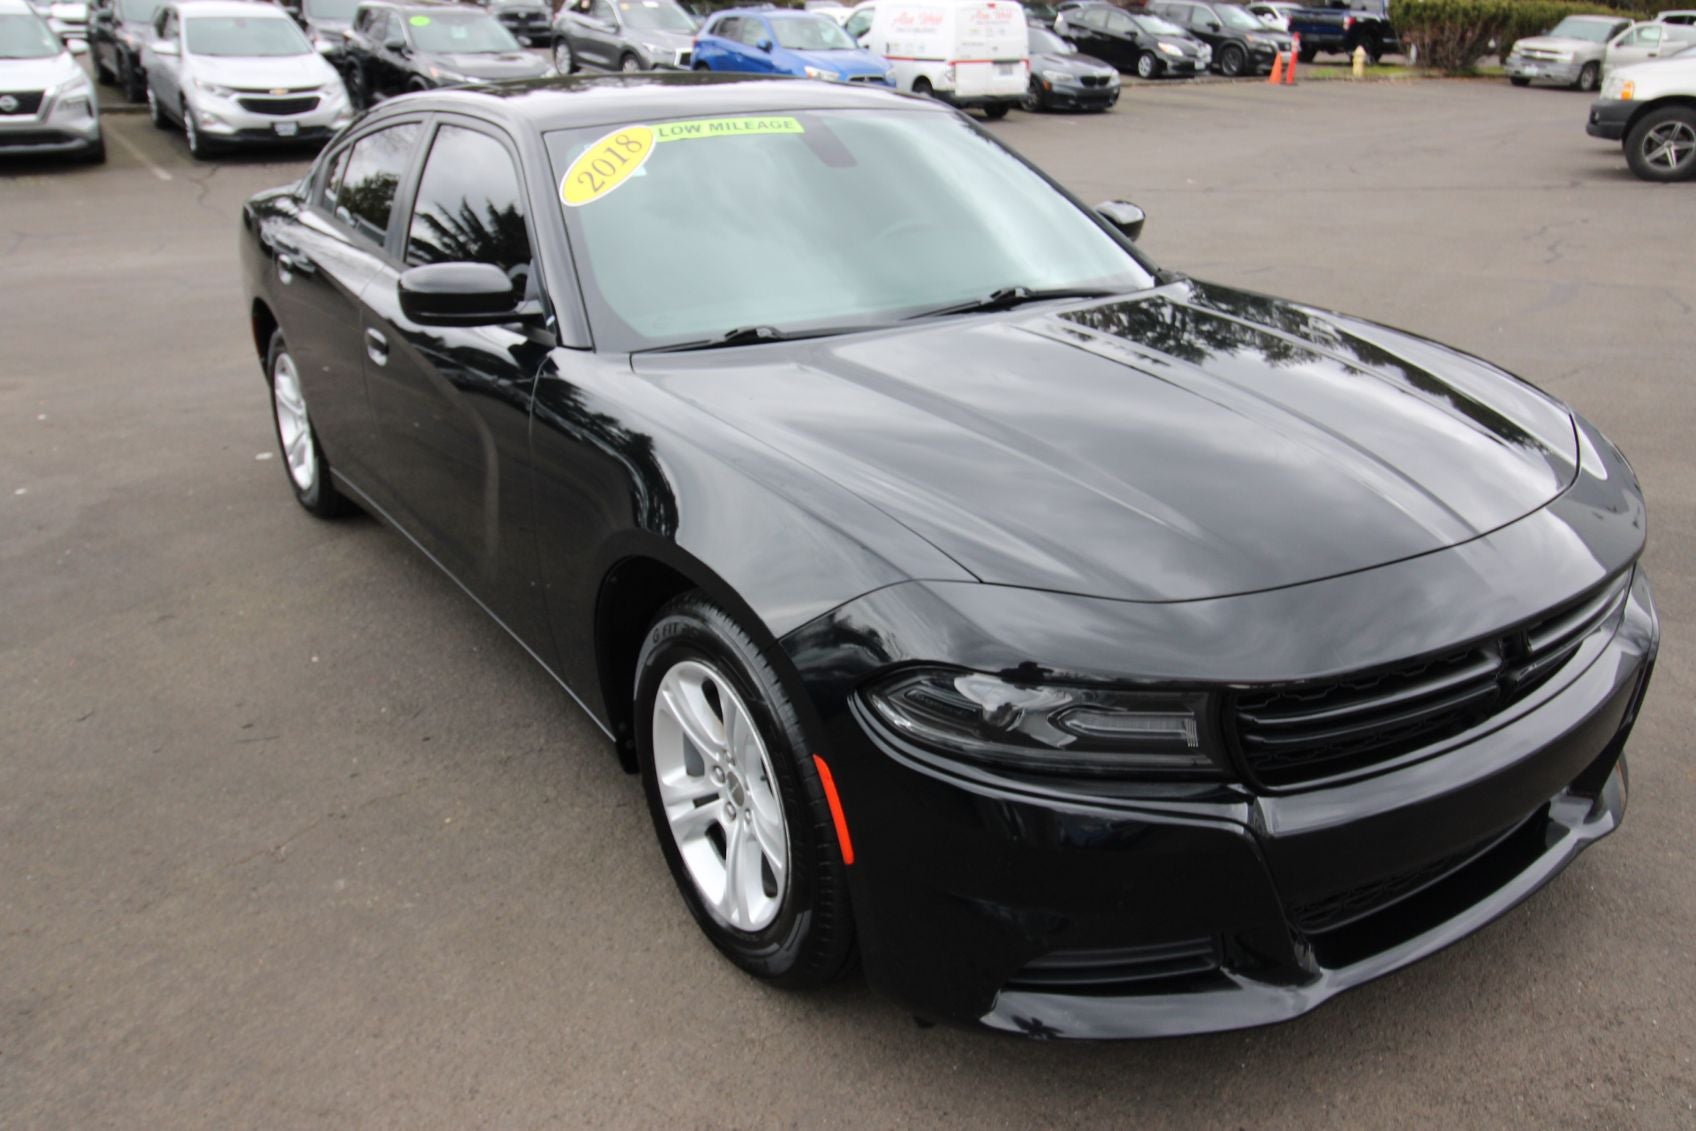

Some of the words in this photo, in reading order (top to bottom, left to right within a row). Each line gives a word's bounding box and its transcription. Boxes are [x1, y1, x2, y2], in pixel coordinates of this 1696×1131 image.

[658, 124, 701, 138] LOW
[709, 118, 796, 132] MILEAGE
[576, 133, 643, 193] 2018
